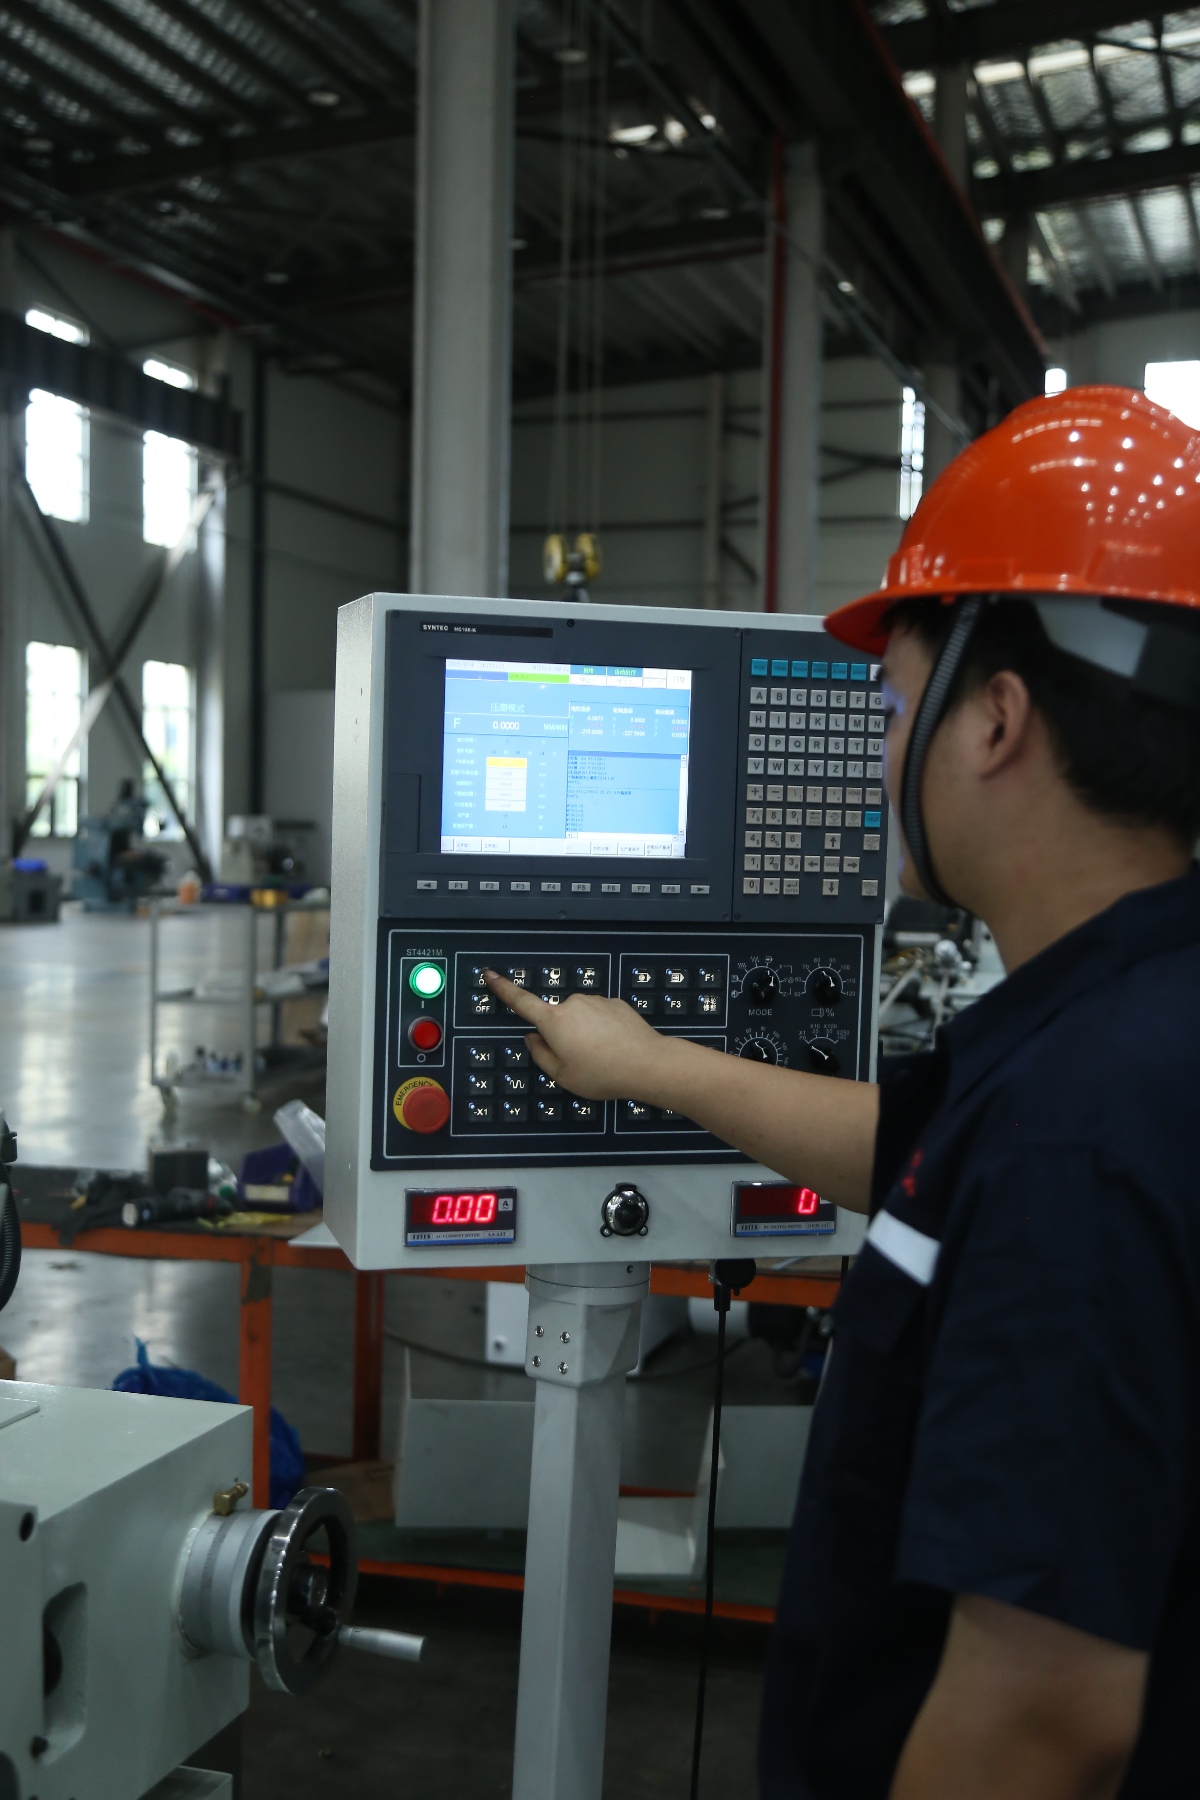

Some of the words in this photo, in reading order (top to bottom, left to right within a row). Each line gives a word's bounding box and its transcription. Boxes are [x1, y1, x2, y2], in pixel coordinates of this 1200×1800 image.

[454, 718, 461, 728] F
[493, 721, 519, 730] 0.0000
[754, 739, 761, 747] O
[814, 764, 820, 772] Y
[771, 834, 776, 843] 5
[798, 1188, 816, 1213] 0
[432, 1196, 496, 1222] 0.00
